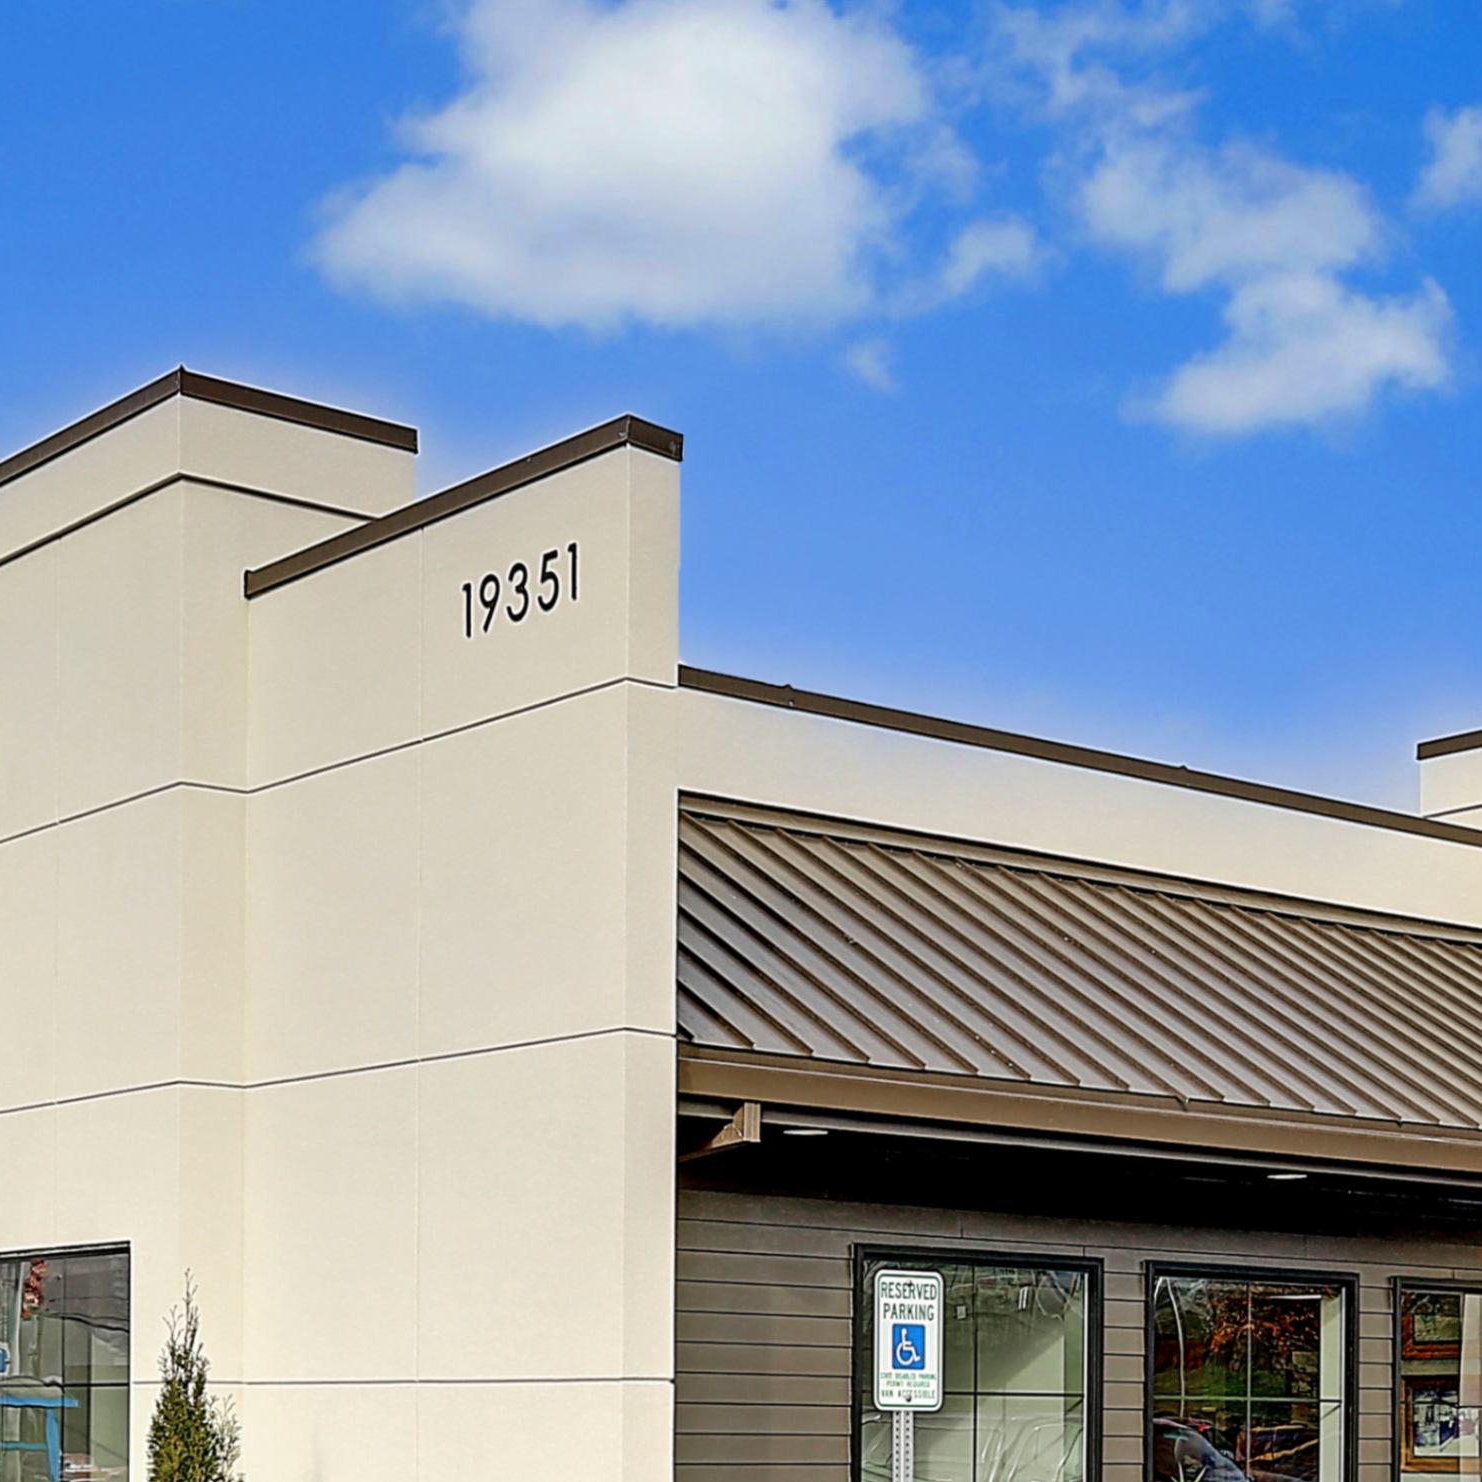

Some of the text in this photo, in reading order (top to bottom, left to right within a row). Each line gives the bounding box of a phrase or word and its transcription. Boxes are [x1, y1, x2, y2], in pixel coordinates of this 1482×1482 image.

[462, 542, 577, 638] 19351
[880, 1281, 937, 1301] RESERVED
[883, 1304, 934, 1321] PARKING
